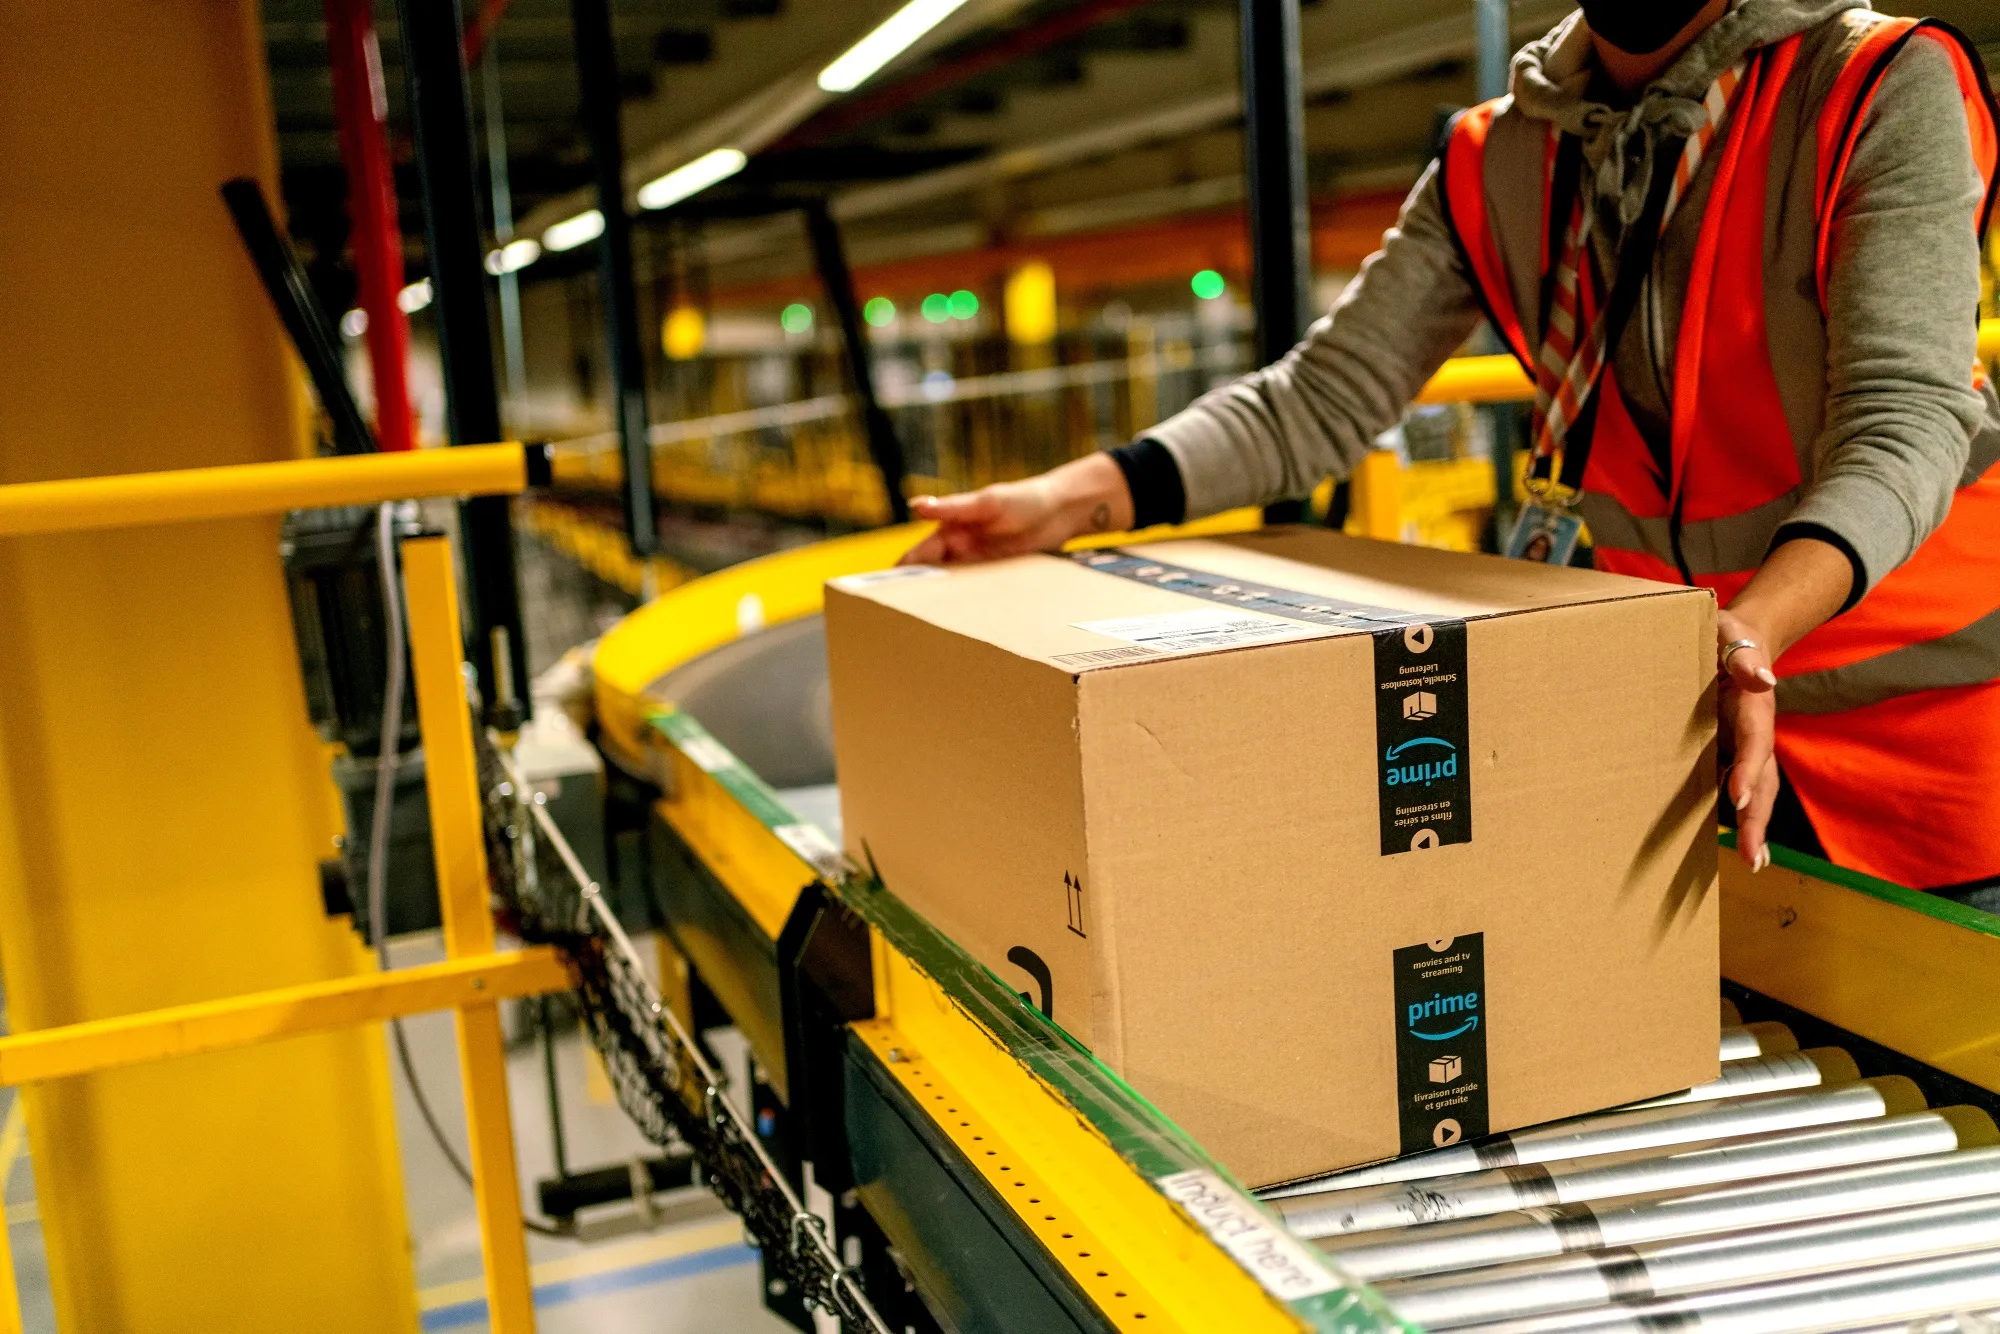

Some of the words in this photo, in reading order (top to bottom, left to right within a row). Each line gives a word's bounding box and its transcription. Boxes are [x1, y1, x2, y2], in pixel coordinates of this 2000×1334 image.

[1399, 663, 1438, 675] Lieferung
[1386, 752, 1457, 787] prime
[1395, 802, 1439, 816] streaming
[1439, 800, 1451, 808] en
[1394, 816, 1419, 828] séries
[1420, 814, 1430, 822] et
[1431, 811, 1453, 821] films
[1413, 958, 1442, 970] movies
[1444, 953, 1460, 964] and
[1461, 952, 1471, 960] tv
[1421, 965, 1463, 979] streaming
[1408, 992, 1478, 1027] prime
[1414, 1088, 1450, 1103] livraison
[1451, 1082, 1478, 1095] rapide
[1424, 1102, 1434, 1111] et
[1435, 1095, 1469, 1110] gratuite
[1170, 1172, 1259, 1237] Induct
[1244, 1237, 1313, 1288] here
